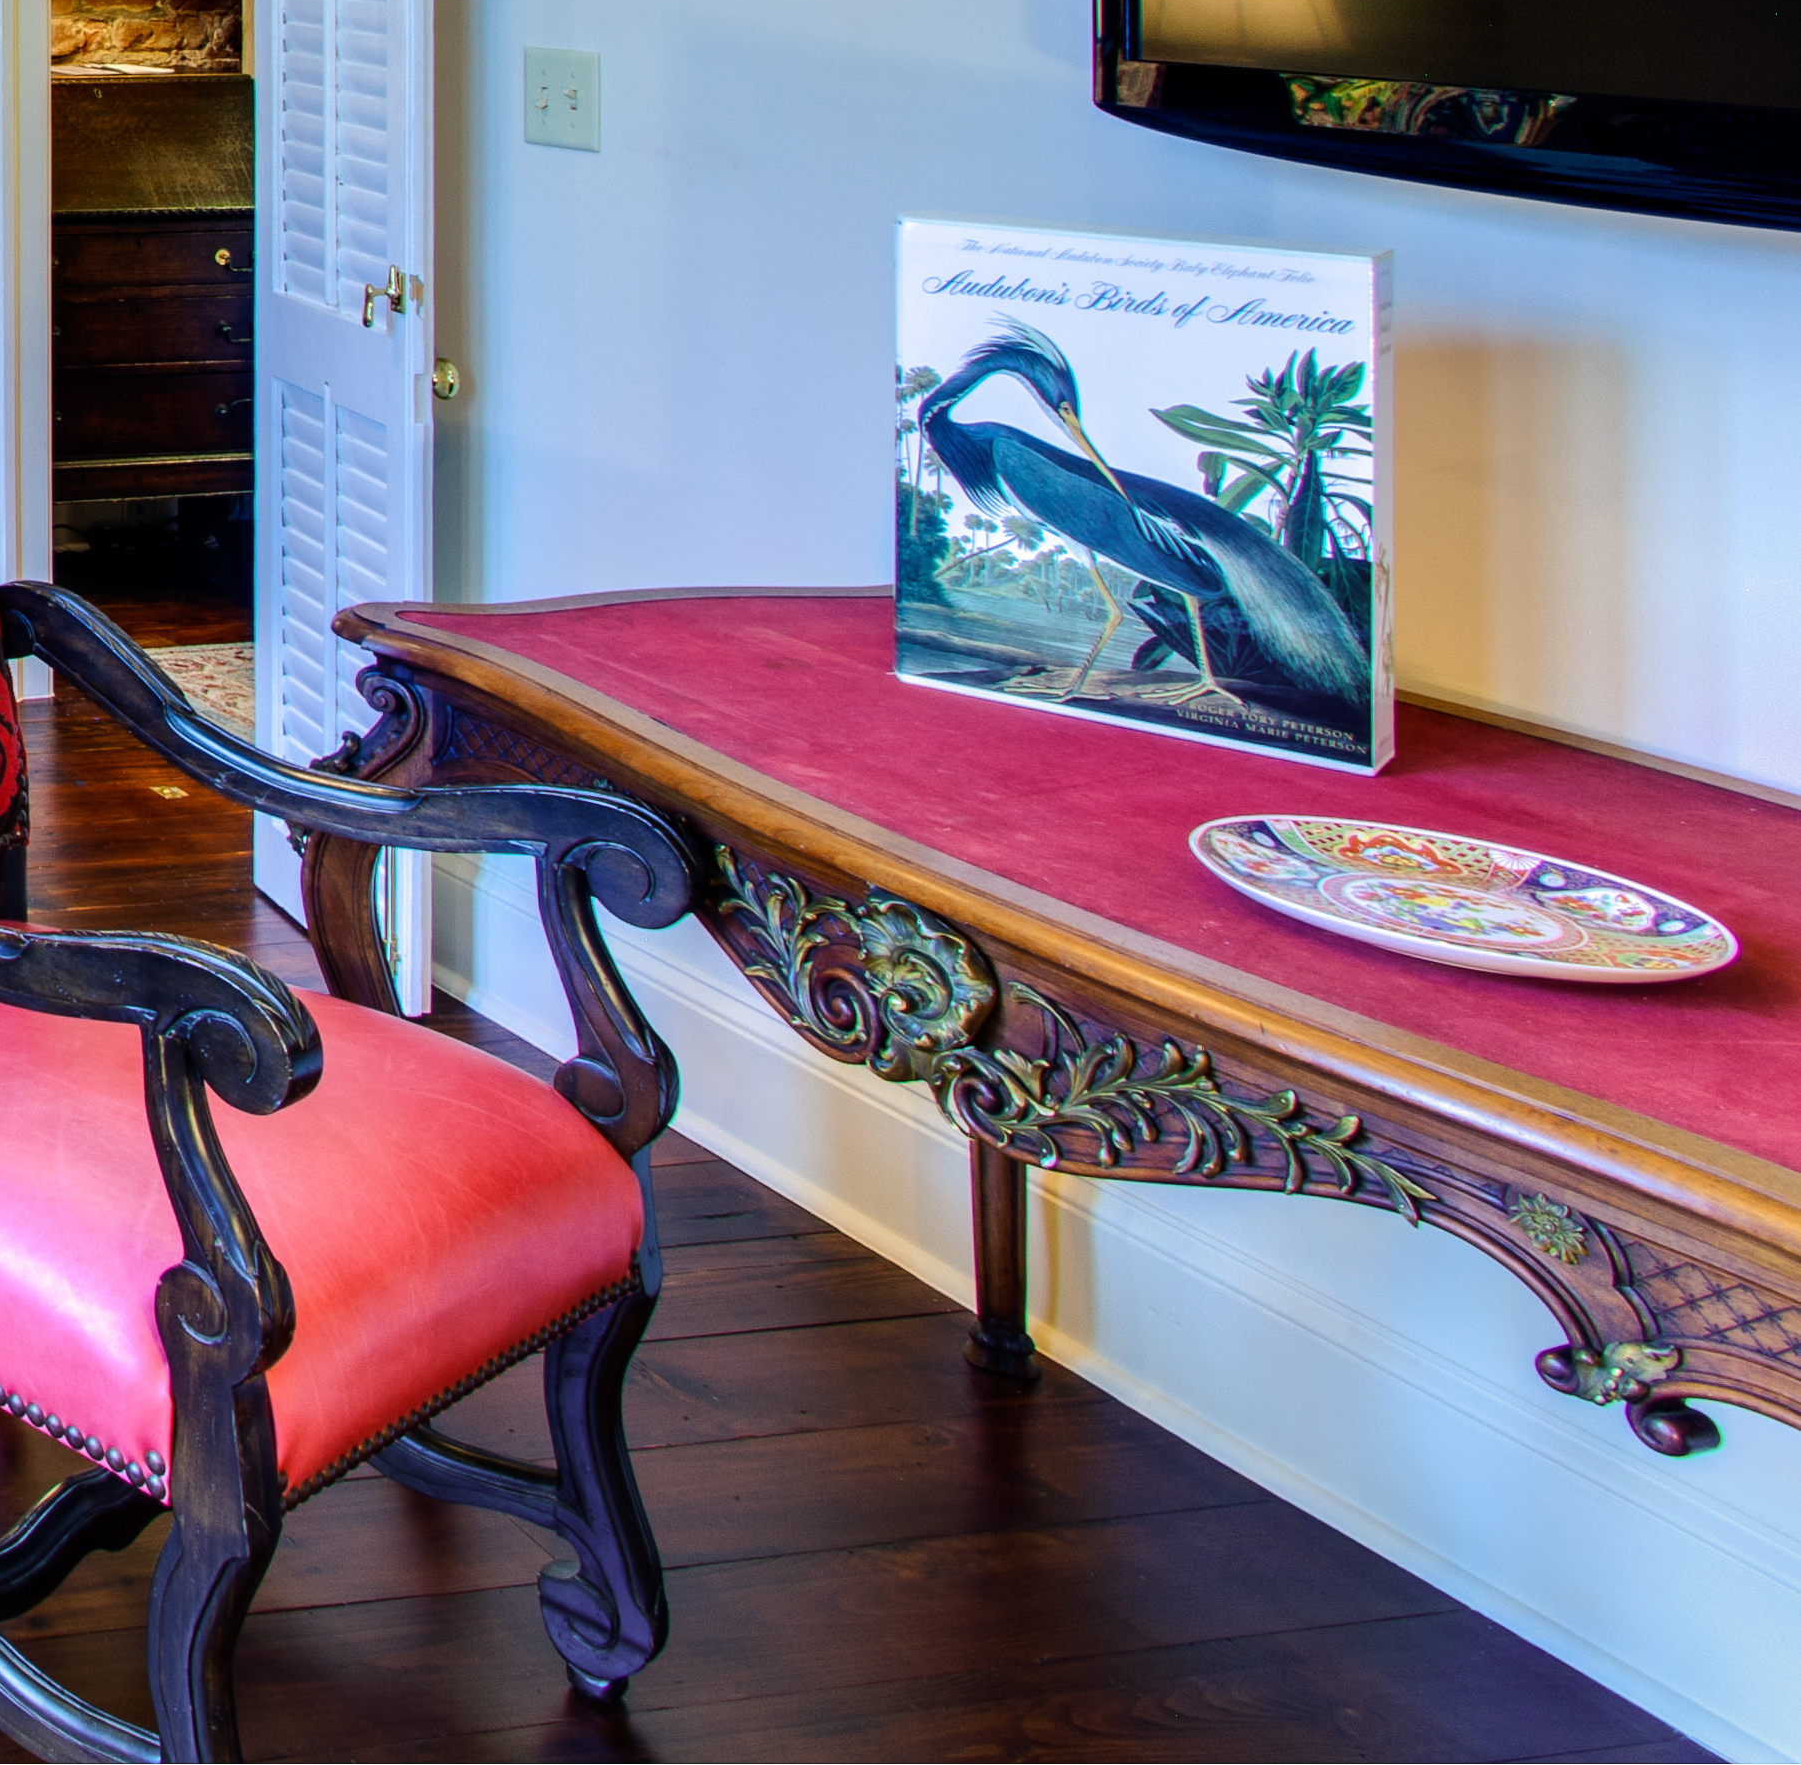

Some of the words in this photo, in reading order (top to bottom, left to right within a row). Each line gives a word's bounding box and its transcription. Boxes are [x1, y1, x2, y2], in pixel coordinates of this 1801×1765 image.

[956, 238, 984, 252] The
[984, 243, 1052, 259] National
[1049, 248, 1113, 265] Audubon
[1115, 255, 1165, 273] Society
[1165, 257, 1209, 276] Baby
[1209, 261, 1275, 280] Elephant
[1275, 268, 1318, 283] Folio
[921, 269, 1073, 306] Audubon's
[1074, 280, 1170, 316] Birds
[1171, 295, 1210, 330] of
[1206, 297, 1356, 335] America
[1176, 709, 1240, 730] VIRGINIA
[1245, 722, 1290, 739] MARIE
[1295, 733, 1369, 755] PETERSON
[1188, 701, 1236, 718] ROGER
[1240, 710, 1276, 727] TORY
[1281, 719, 1355, 742] PETERSON
